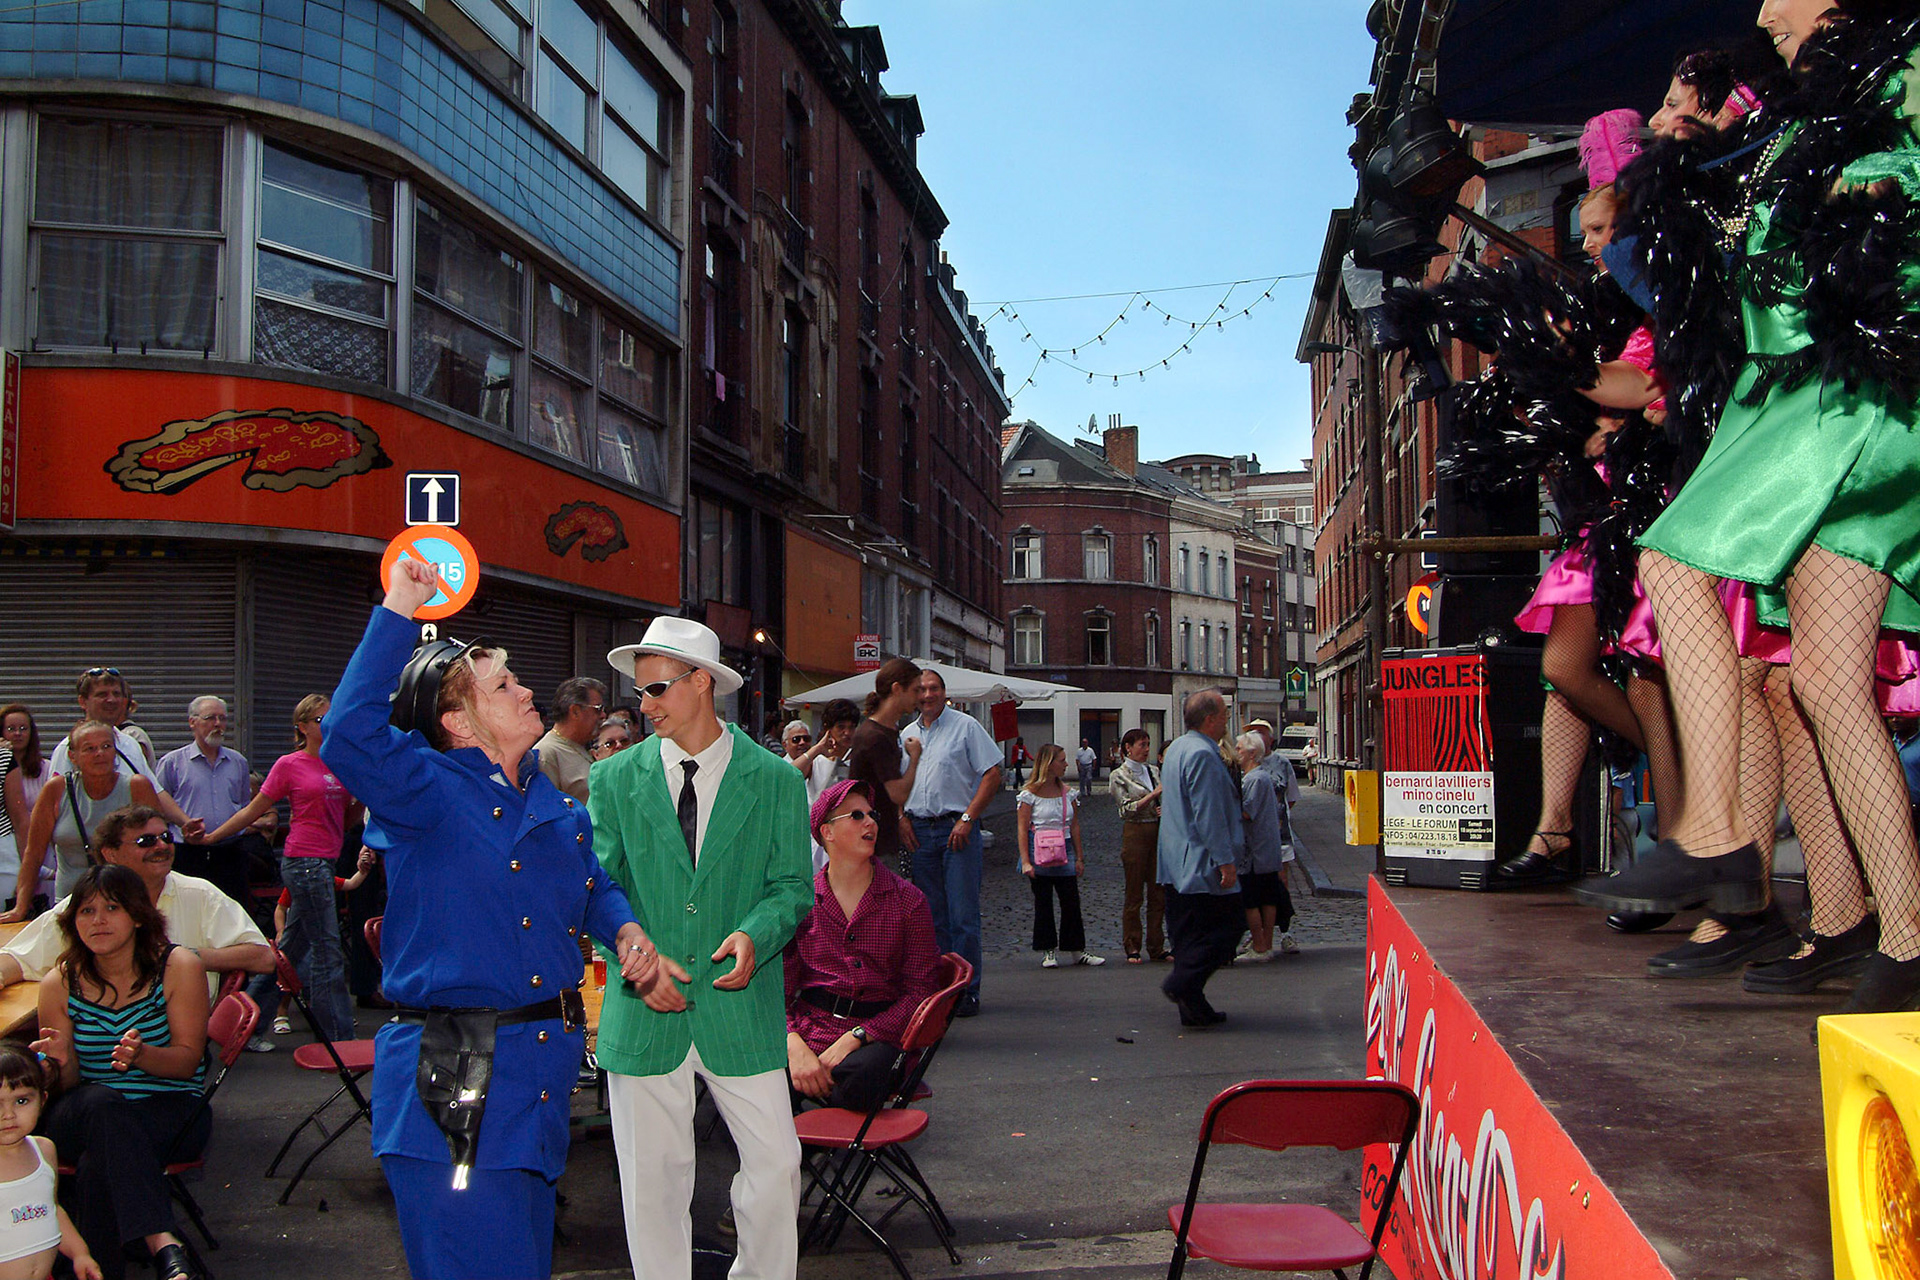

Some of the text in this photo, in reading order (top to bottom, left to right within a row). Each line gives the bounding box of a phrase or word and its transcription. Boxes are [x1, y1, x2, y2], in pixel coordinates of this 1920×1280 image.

[4, 354, 15, 424] PITA
[2, 447, 12, 514] 2002
[859, 649, 876, 657] EHC
[1382, 662, 1490, 690] JUNGLES
[1385, 775, 1492, 788] bernard lavilliers
[1402, 788, 1475, 801] mino cinelu
[1418, 803, 1489, 815] en concert
[1384, 818, 1406, 828] IEGE
[1411, 819, 1423, 828] LE
[1424, 819, 1457, 829] FORUM
[1408, 831, 1458, 841] 04/223.18.18
[11, 1203, 48, 1224] Miss
